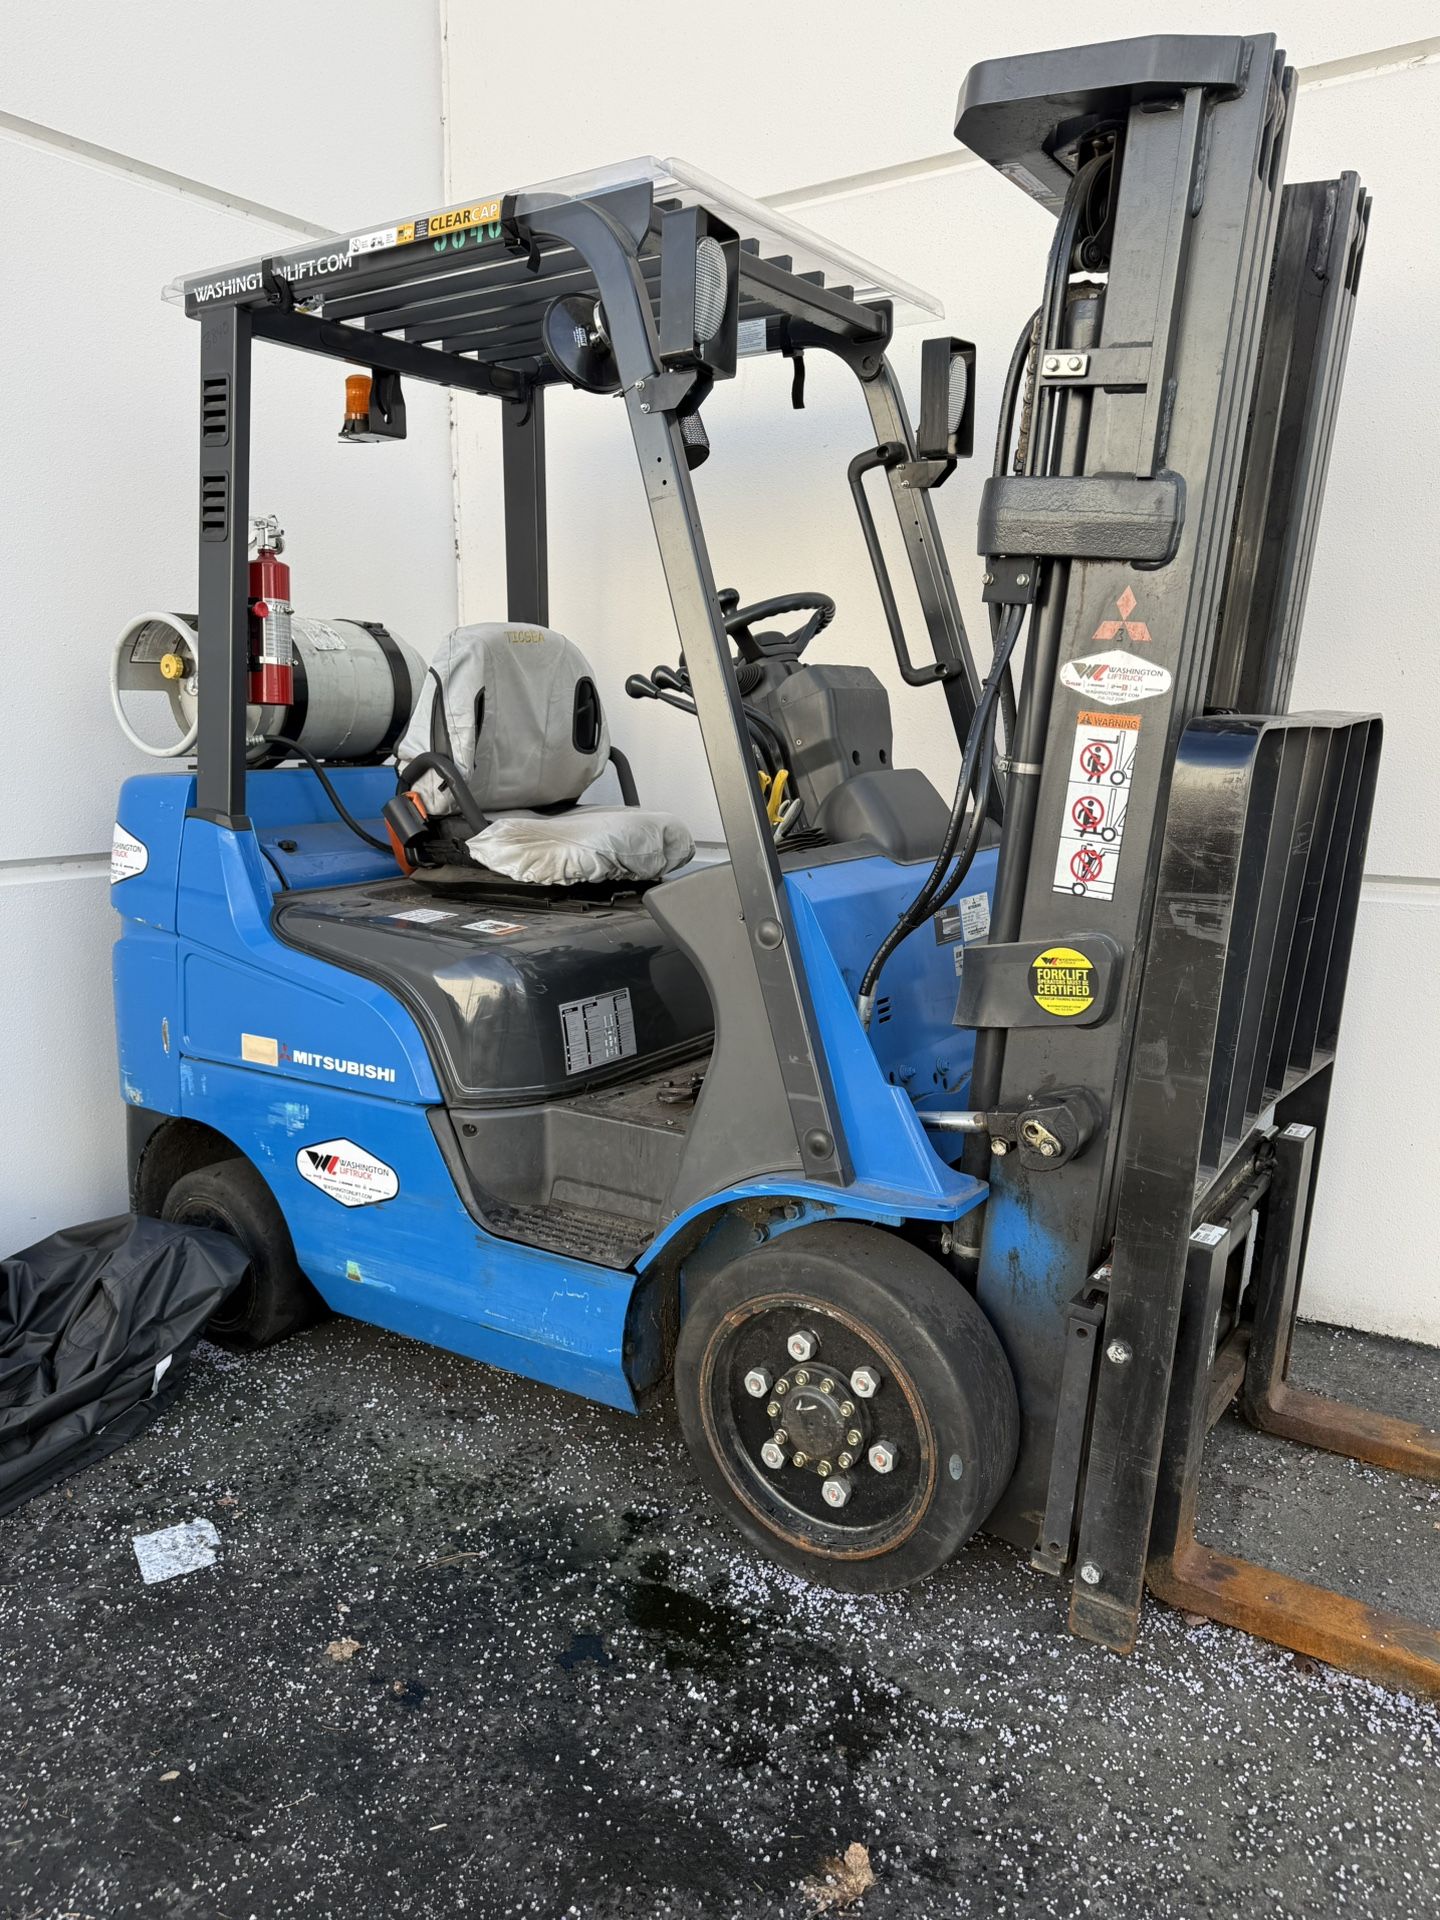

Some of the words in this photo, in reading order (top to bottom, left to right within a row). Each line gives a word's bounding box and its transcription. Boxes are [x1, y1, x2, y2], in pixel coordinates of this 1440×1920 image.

[430, 203, 498, 231] CLEARCAP
[194, 252, 353, 302] WASHINGTNLIFT.COM
[1108, 665, 1163, 677] WASHINGTON
[1106, 674, 1143, 682] LIFTRUCK
[1095, 716, 1138, 729] WARNING
[1037, 968, 1089, 980] FORKLIFT
[1037, 985, 1090, 996] CERTIFIED
[292, 1050, 395, 1083] MITSUBISHI
[339, 1159, 390, 1177] WASHINGTON
[339, 1167, 373, 1181] LIFTRUCK
